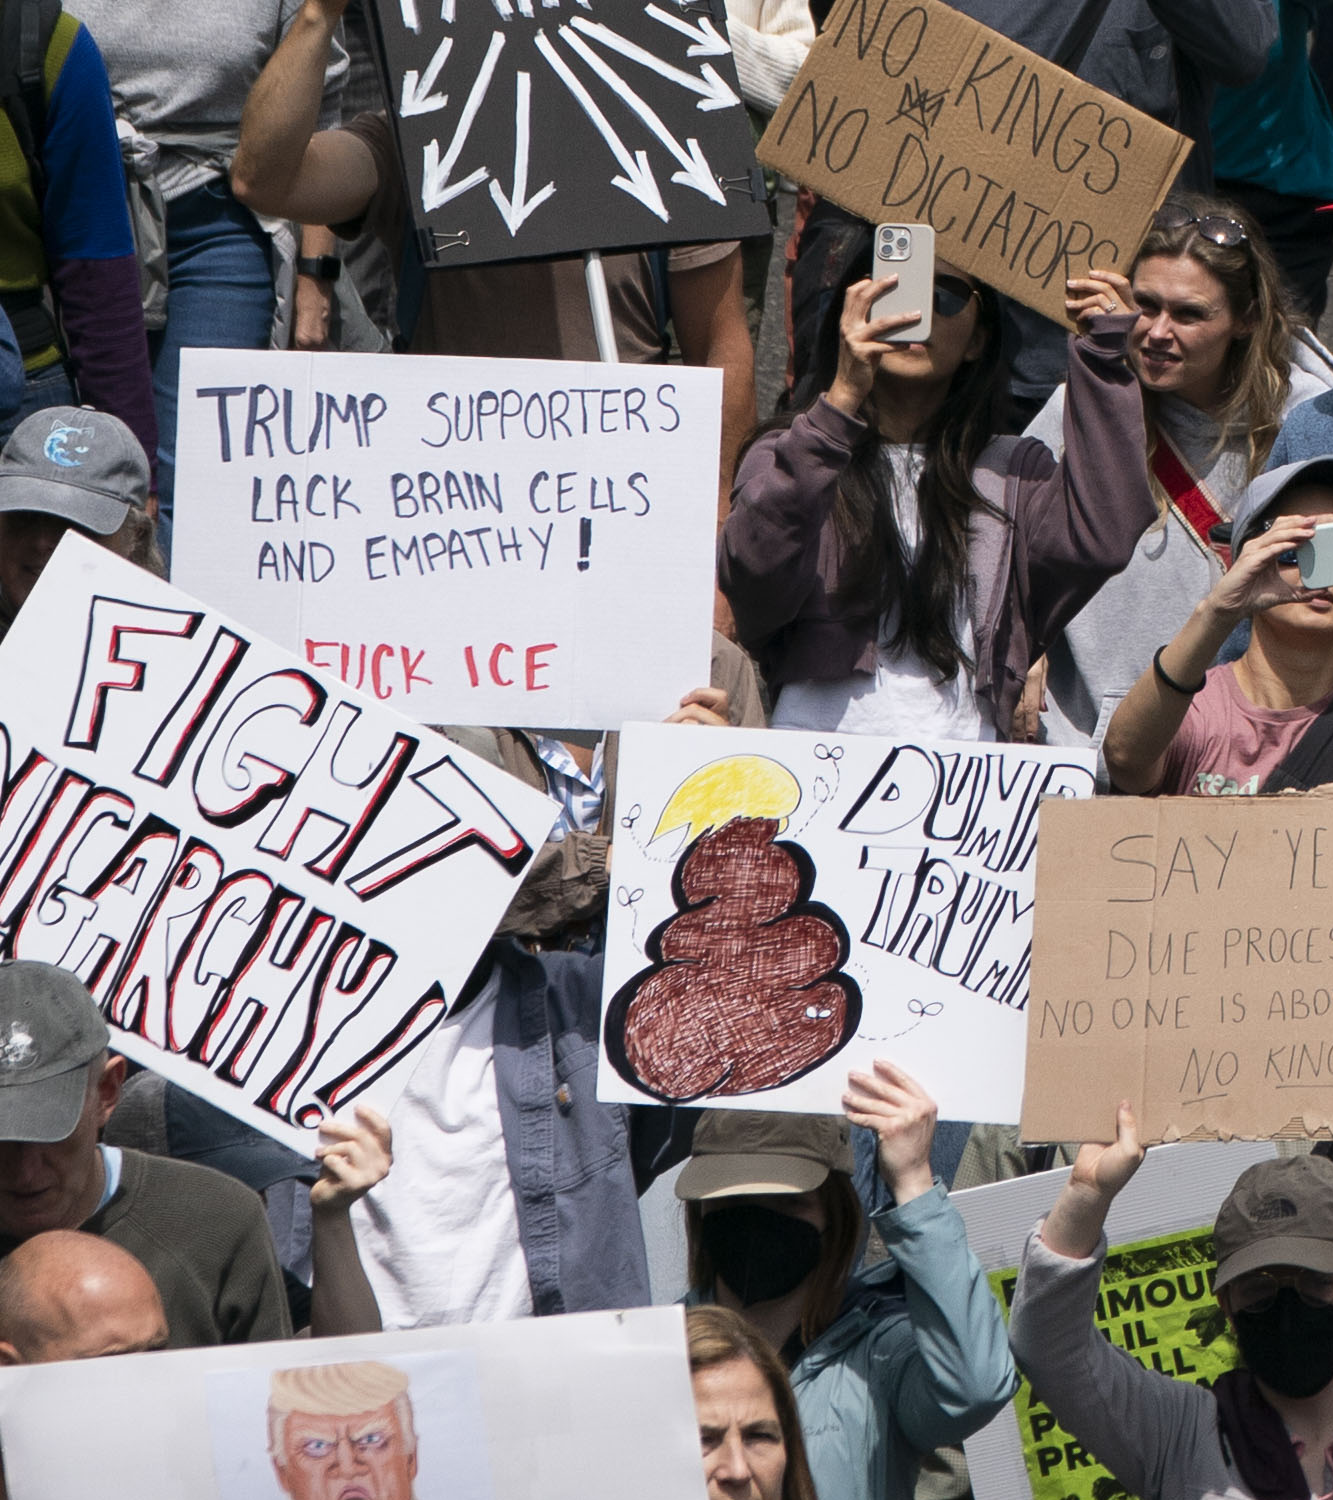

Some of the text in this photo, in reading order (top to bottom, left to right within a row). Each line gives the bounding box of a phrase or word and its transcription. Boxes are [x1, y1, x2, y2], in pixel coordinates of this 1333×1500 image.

[251, 470, 652, 524] LACK BRAIN CELLS
[304, 638, 559, 700] FUCK ICE
[1104, 926, 1200, 982] DUE
[1038, 998, 1096, 1042] NO
[1111, 992, 1193, 1033] ONE
[1218, 989, 1247, 1025] IS
[1179, 1046, 1240, 1098] NO
